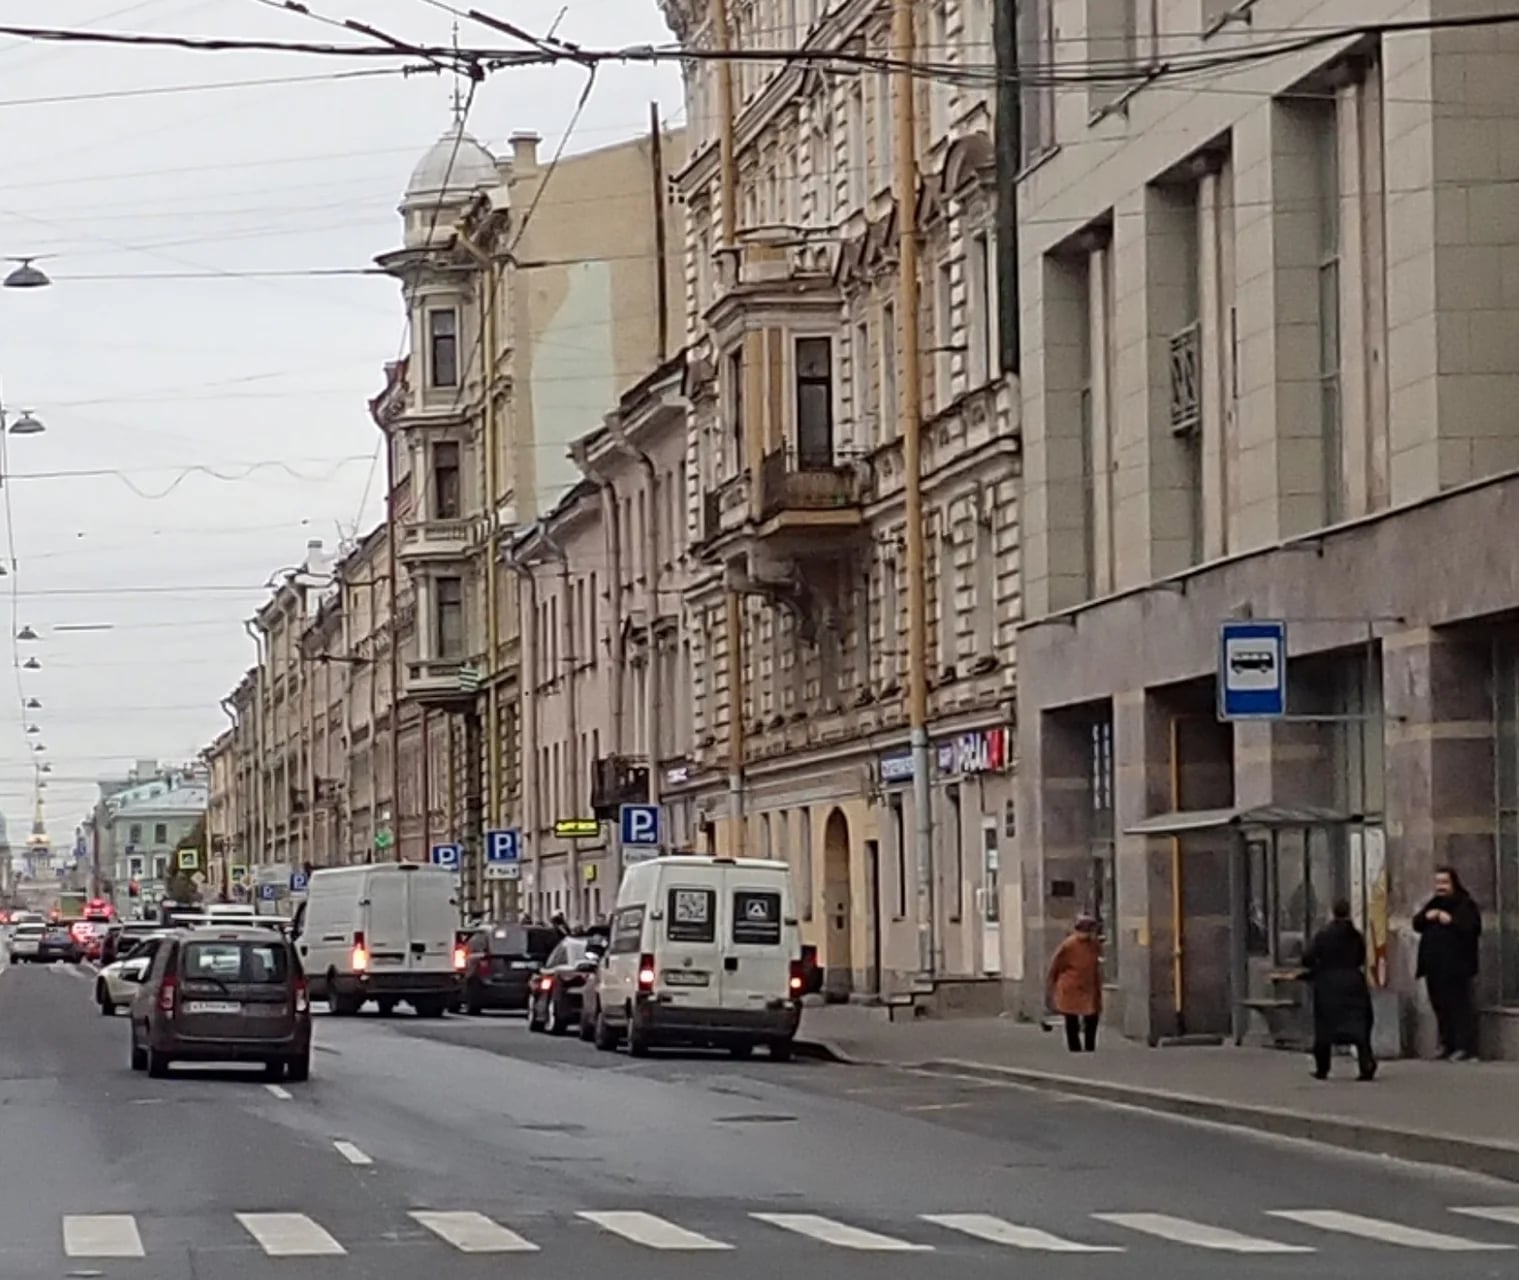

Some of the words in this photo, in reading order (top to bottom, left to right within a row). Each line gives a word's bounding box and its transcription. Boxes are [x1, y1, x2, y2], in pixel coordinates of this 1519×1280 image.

[631, 809, 654, 841] P
[438, 847, 457, 864] P
[494, 833, 512, 858] P
